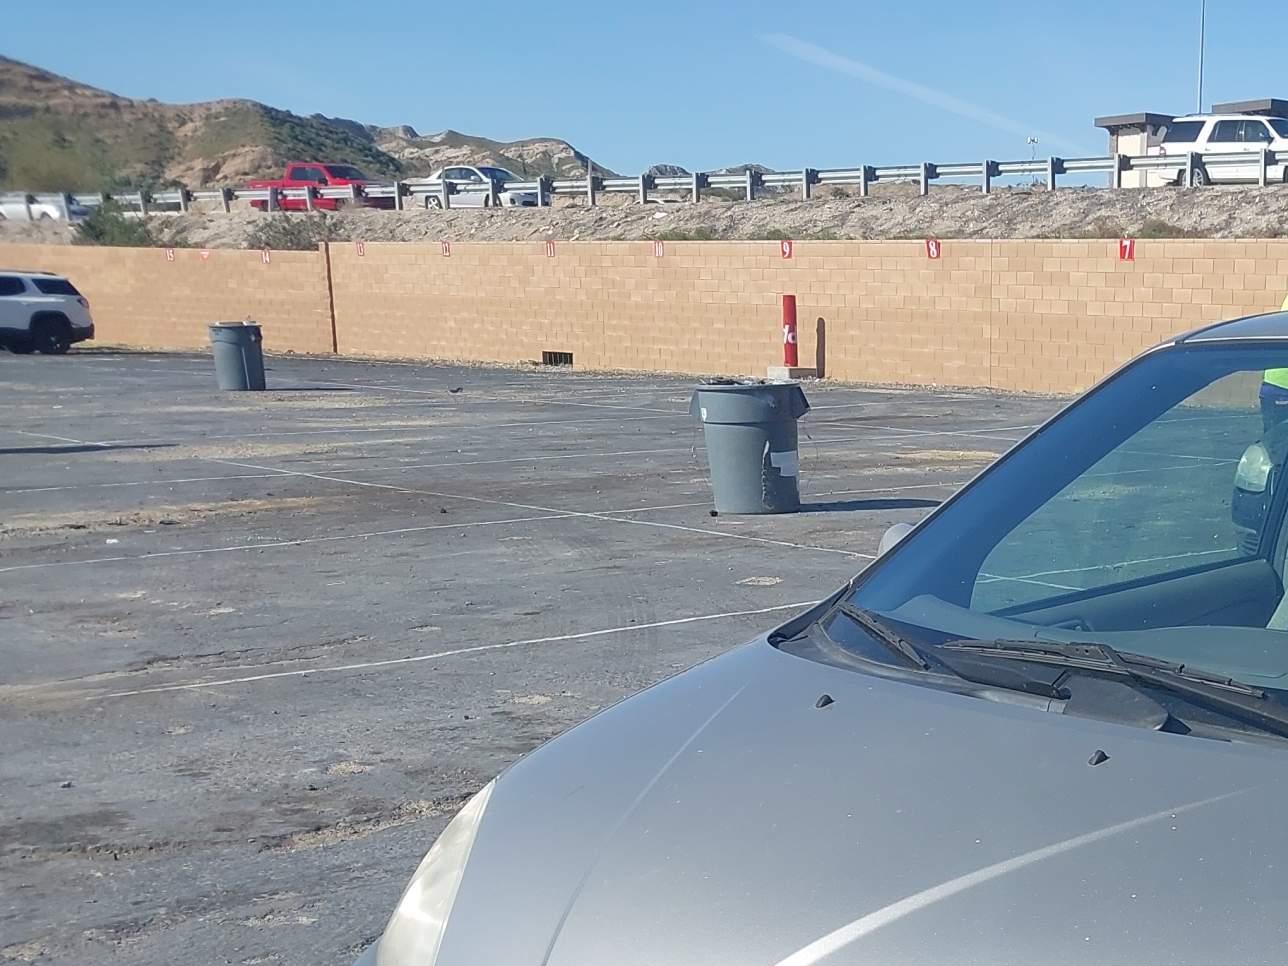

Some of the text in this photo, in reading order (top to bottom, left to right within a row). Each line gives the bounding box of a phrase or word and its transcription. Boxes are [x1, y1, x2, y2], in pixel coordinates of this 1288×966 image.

[655, 241, 663, 256] 10
[783, 241, 790, 257] 9
[929, 240, 937, 257] 8
[1122, 240, 1130, 259] 7
